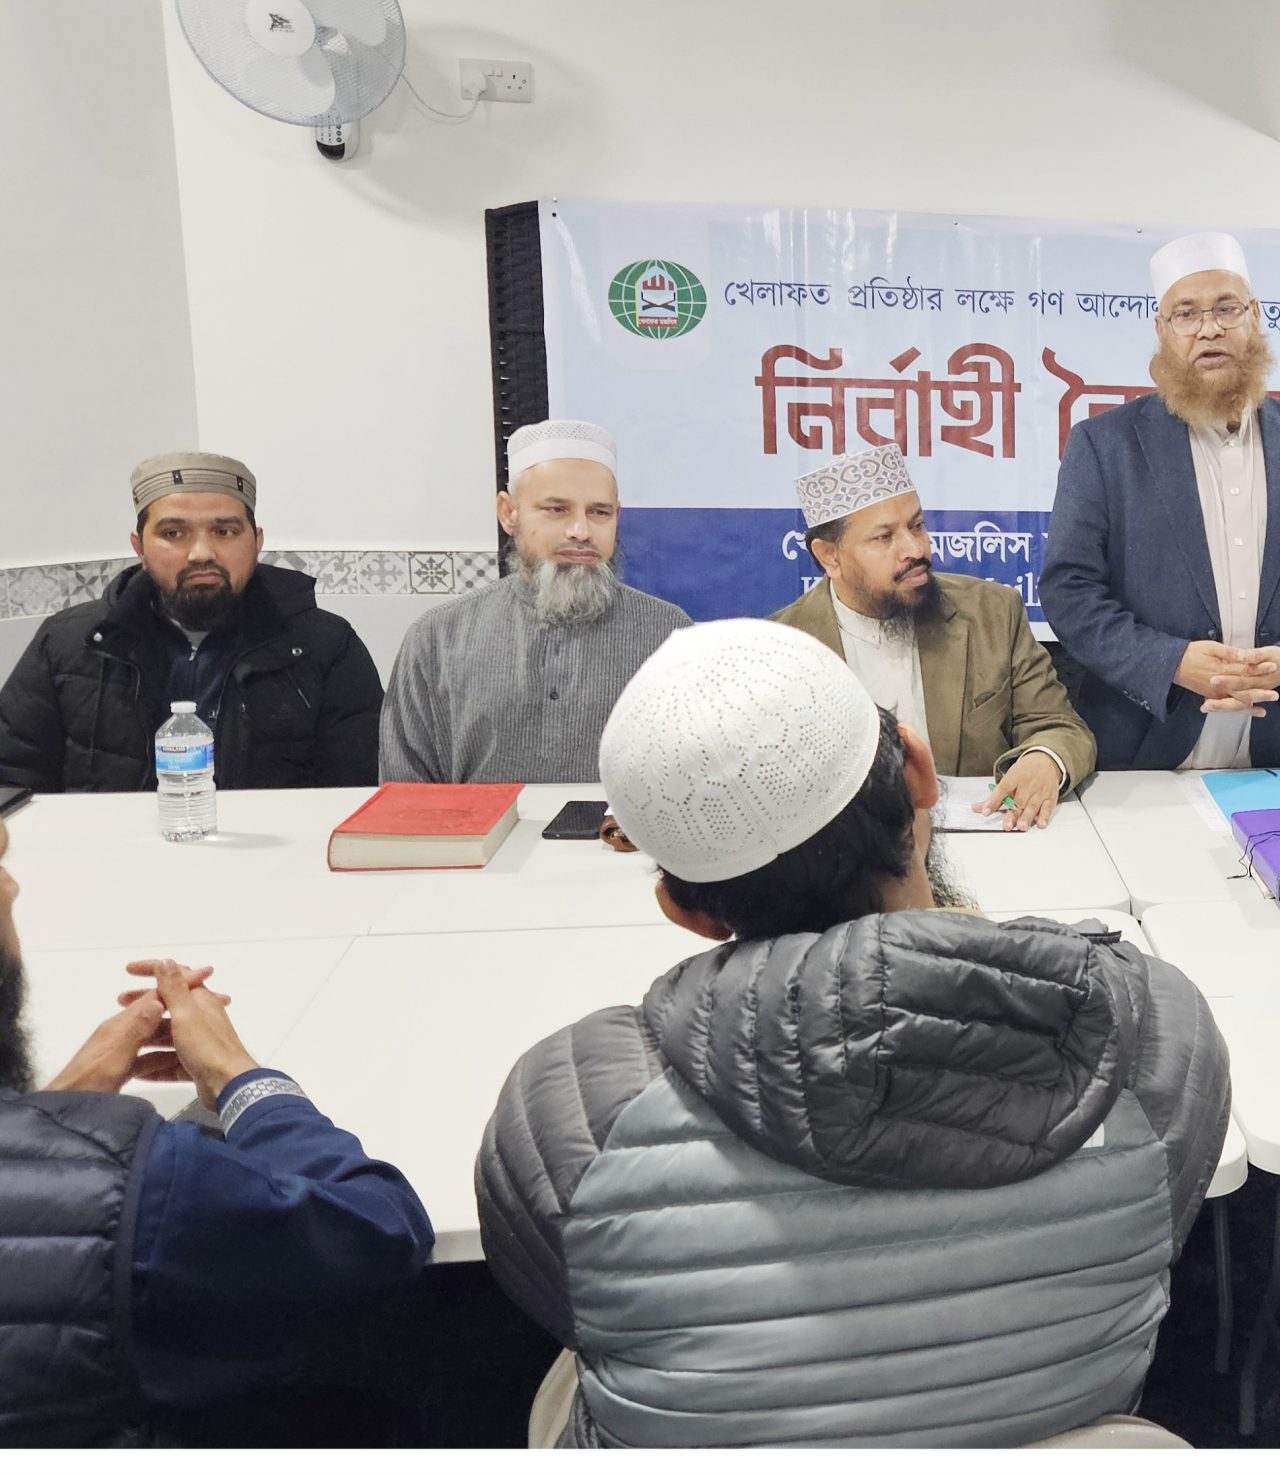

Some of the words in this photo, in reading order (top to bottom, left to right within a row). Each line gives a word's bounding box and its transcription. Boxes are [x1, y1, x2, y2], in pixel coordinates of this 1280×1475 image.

[724, 279, 831, 308] খেলাফত
[848, 276, 944, 312] প্রতিষ্ঠার
[955, 286, 1015, 314] লক্ষে
[1029, 289, 1065, 316] গণ
[754, 342, 1022, 458] নির্বাহী
